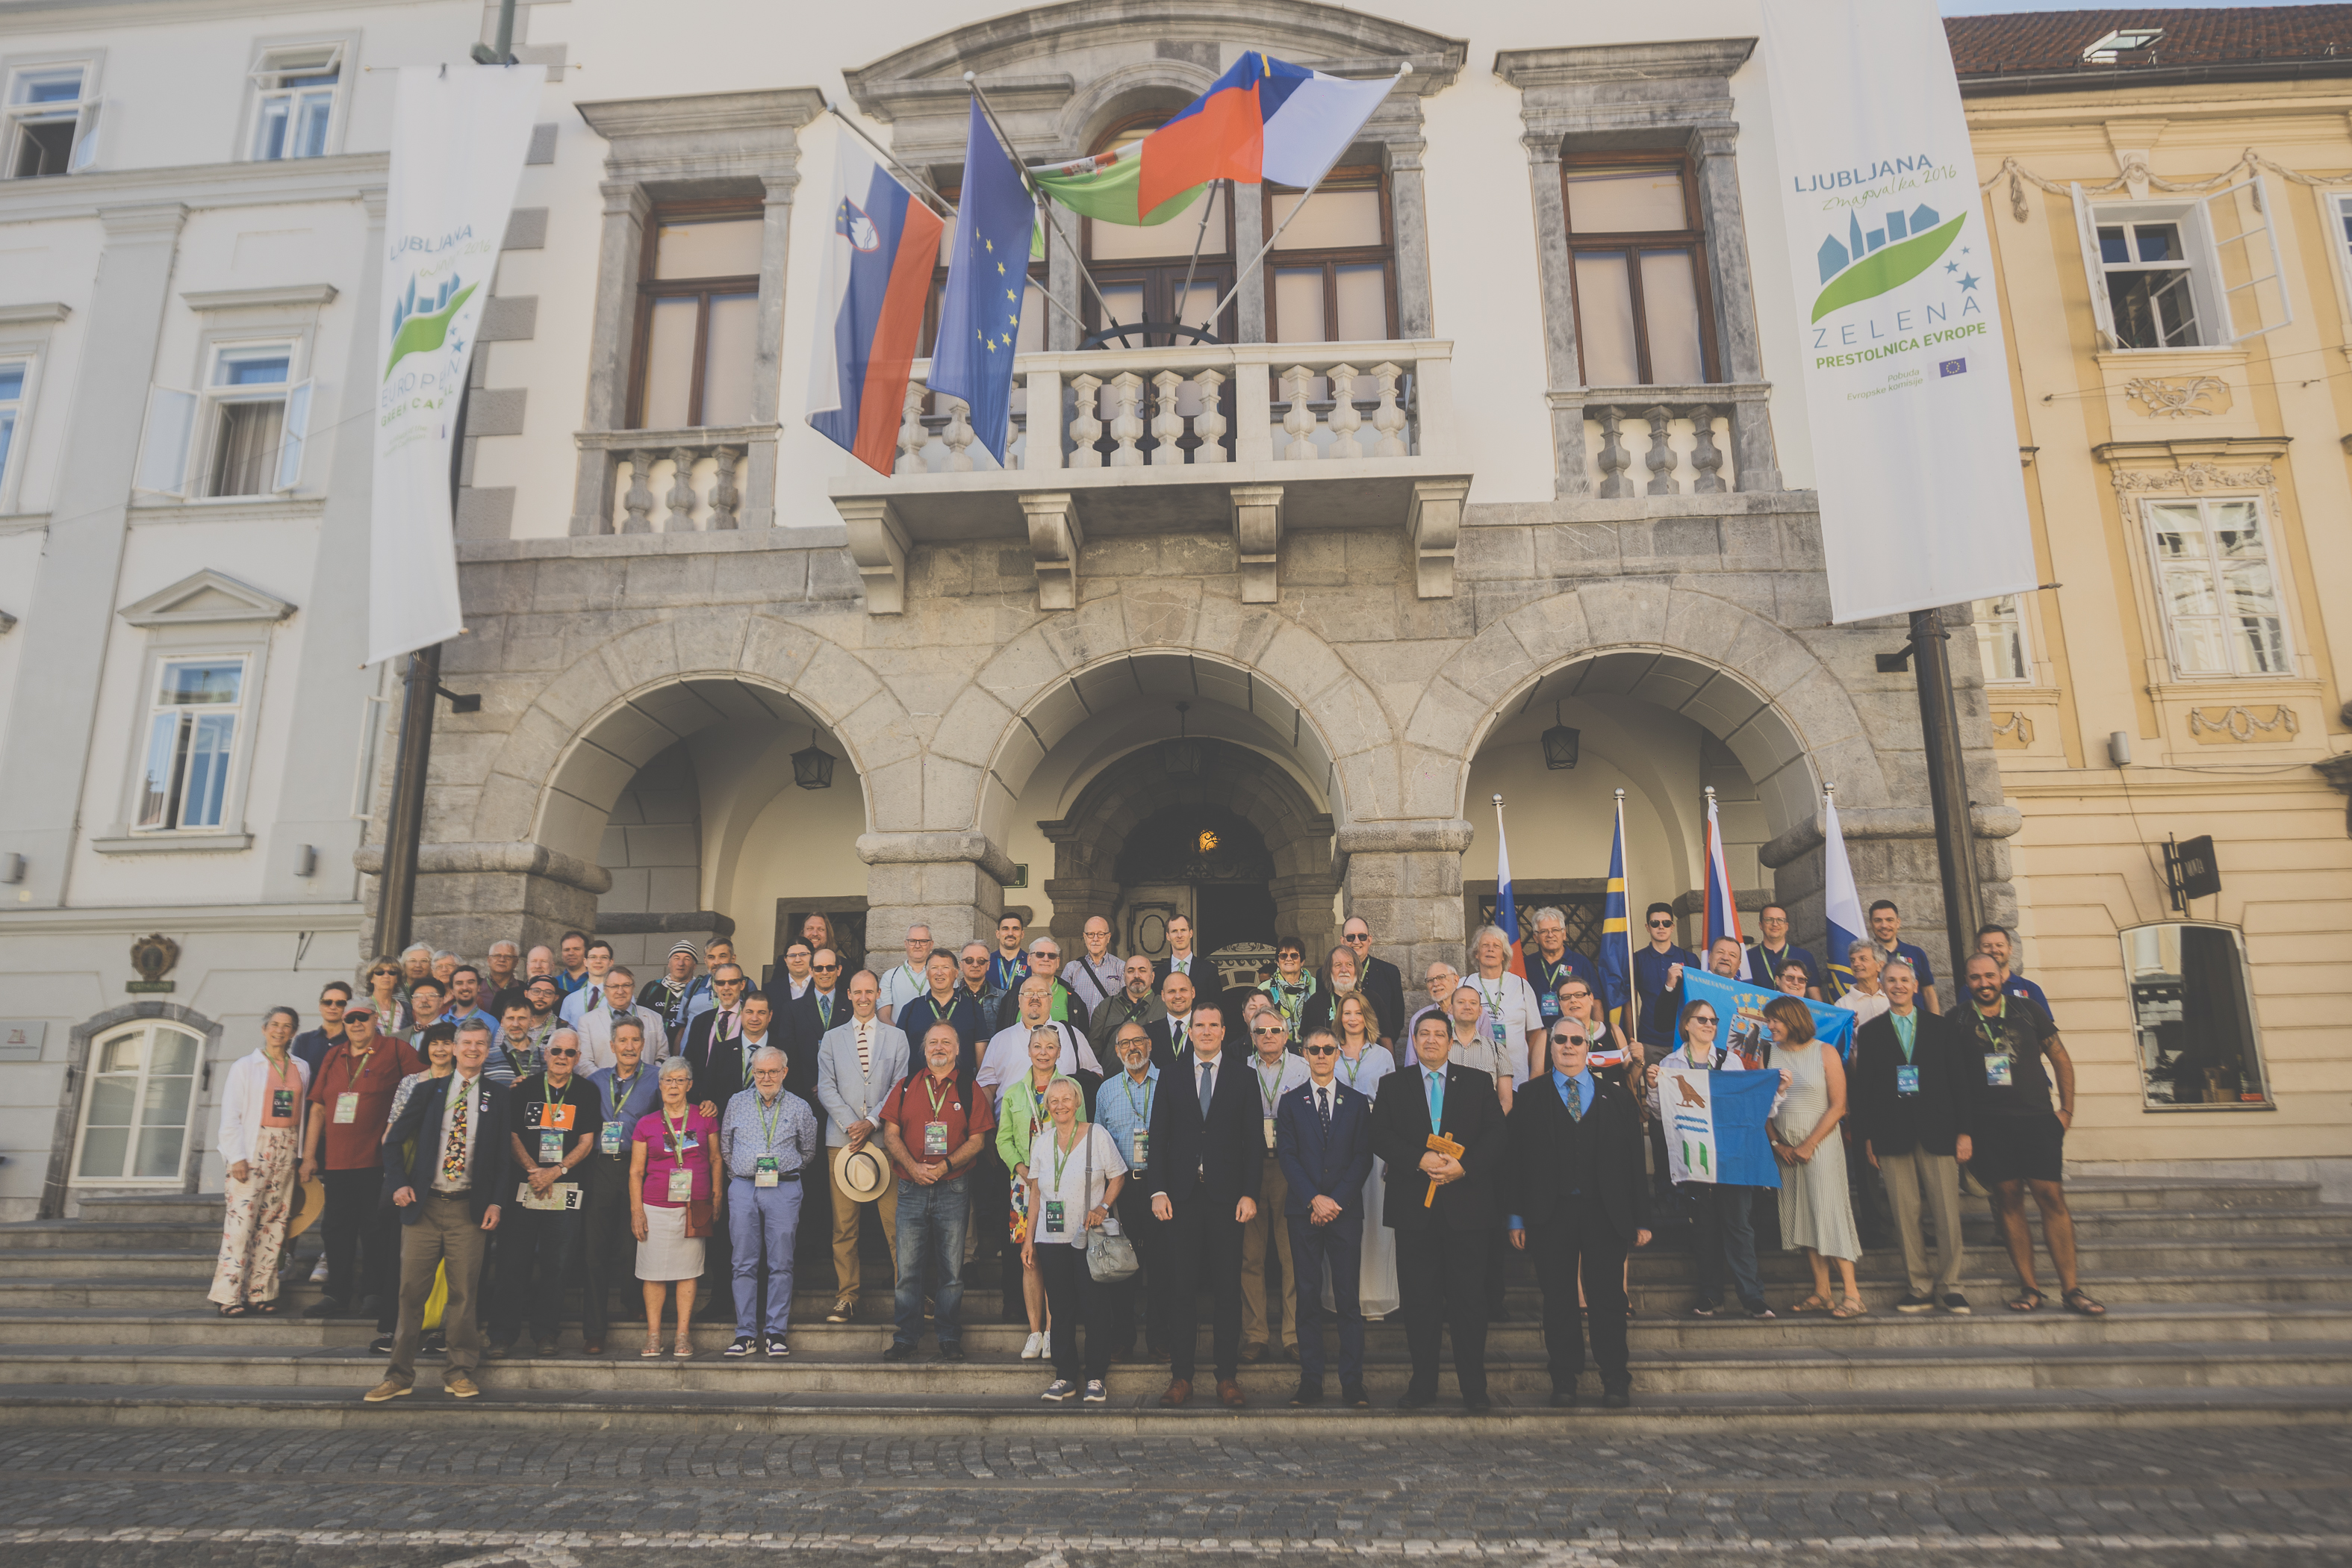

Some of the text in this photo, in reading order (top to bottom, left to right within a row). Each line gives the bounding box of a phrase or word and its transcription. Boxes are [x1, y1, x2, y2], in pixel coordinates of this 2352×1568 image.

[1794, 154, 1934, 193] LJUBLJANA
[1822, 164, 1957, 211] zmagovalka 2016
[464, 239, 491, 255] 2016
[1812, 296, 1981, 349] ZELENA
[1816, 322, 1987, 370] PRESTOLNICA EVROPE
[1847, 377, 1923, 401] Evropske komisije
[1888, 368, 1920, 382] Pobuda
